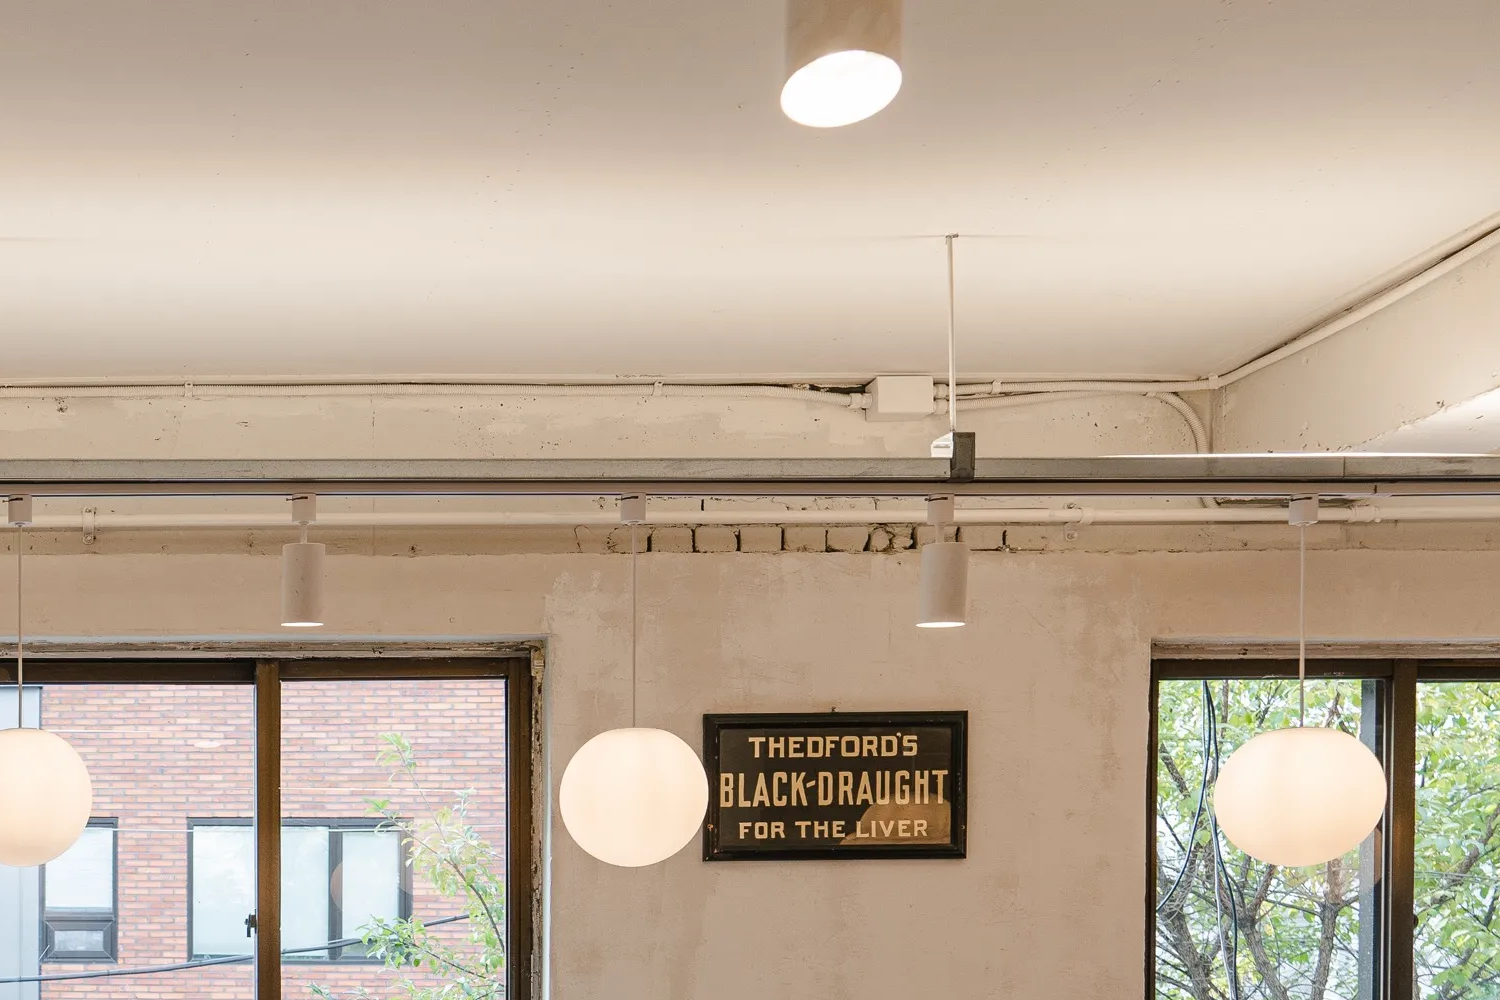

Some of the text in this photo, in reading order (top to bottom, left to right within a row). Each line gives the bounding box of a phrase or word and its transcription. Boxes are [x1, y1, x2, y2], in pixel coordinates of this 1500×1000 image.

[748, 732, 918, 758] THEDFORD'S
[720, 770, 949, 808] BLACK-DRAUGHT
[739, 820, 928, 839] FOR THE LIVER
